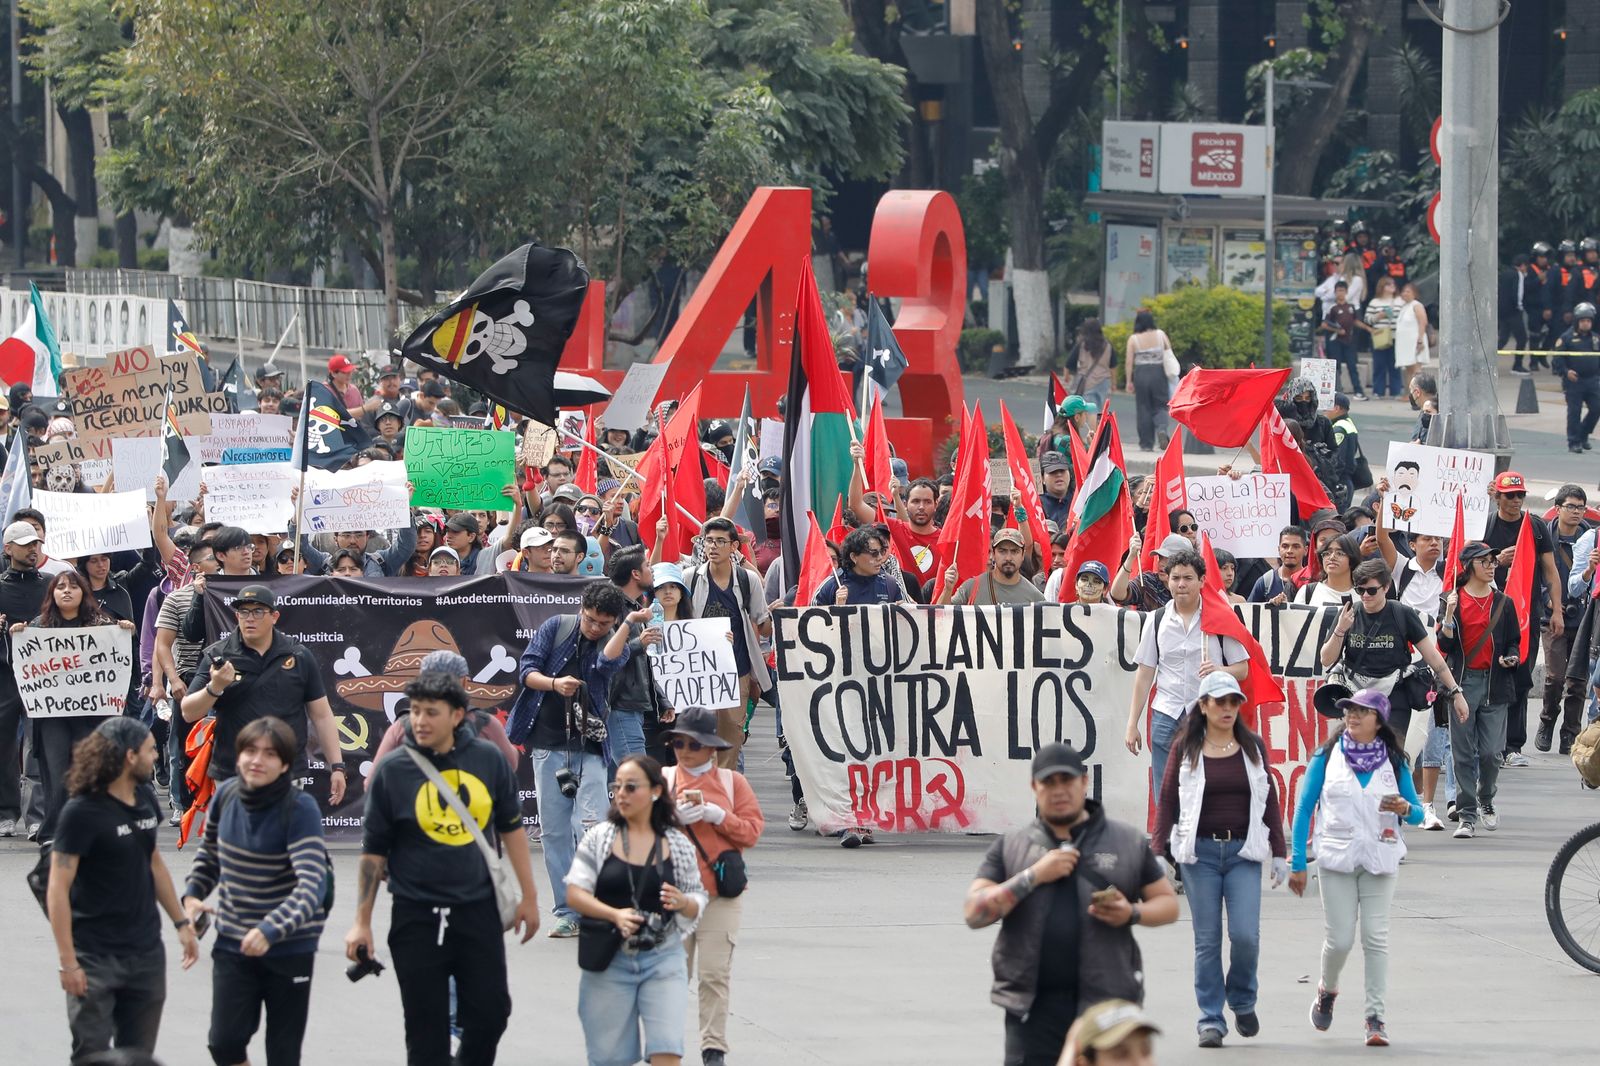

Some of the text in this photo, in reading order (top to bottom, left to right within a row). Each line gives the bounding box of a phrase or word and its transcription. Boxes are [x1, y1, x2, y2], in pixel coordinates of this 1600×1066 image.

[1198, 138, 1237, 146] HECHO EN
[112, 347, 189, 380] NO hay
[72, 379, 189, 412] nada menos
[84, 396, 225, 430] REVOLUCONARIO
[38, 450, 63, 466] que
[66, 441, 85, 461] la
[222, 449, 291, 462] NECESITAMOS EL
[1436, 454, 1483, 472] NI UN
[407, 459, 514, 477] mi VOZ como
[1187, 482, 1225, 502] Que
[1231, 482, 1250, 499] La
[1251, 474, 1286, 500] Paz
[347, 512, 378, 522] ESPALDA
[1214, 499, 1277, 522] Realidad
[98, 521, 129, 548] VIDA
[1221, 520, 1273, 540] Sueño
[435, 591, 583, 606] #AutodeterminaciónDeLos
[17, 633, 98, 660] HAY TANTA
[771, 602, 1094, 681] ESTUDIANTES
[22, 646, 131, 681] SANGRE en tus
[650, 649, 717, 676] RES EN
[20, 674, 60, 694] MANOS
[95, 669, 117, 684] no
[687, 675, 707, 706] DE
[709, 672, 739, 705] PAZ
[25, 697, 43, 713] LA
[809, 670, 1097, 763] CONTRA LOS
